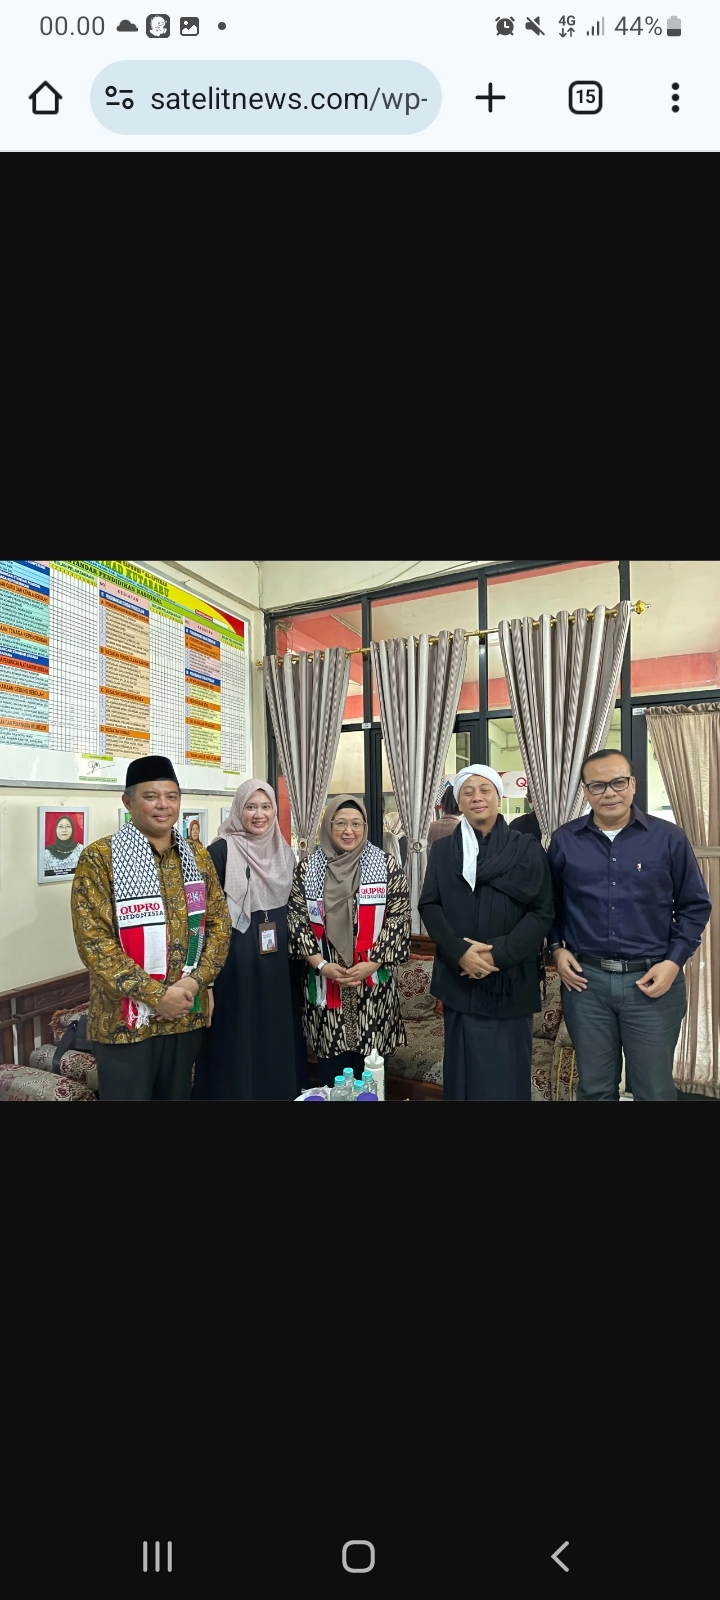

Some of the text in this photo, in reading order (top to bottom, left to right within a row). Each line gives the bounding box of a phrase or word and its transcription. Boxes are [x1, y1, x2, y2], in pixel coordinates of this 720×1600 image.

[40, 15, 105, 36] 00.00
[558, 14, 576, 26] 4G
[614, 15, 663, 37] 44%
[150, 84, 428, 116] satelitnews.com/wp-
[576, 89, 595, 104] 15
[99, 571, 135, 594] PENDIDIKAN
[136, 588, 163, 605] NASIONAL
[126, 568, 169, 597] KUTABARU
[120, 903, 160, 915] QUPRO
